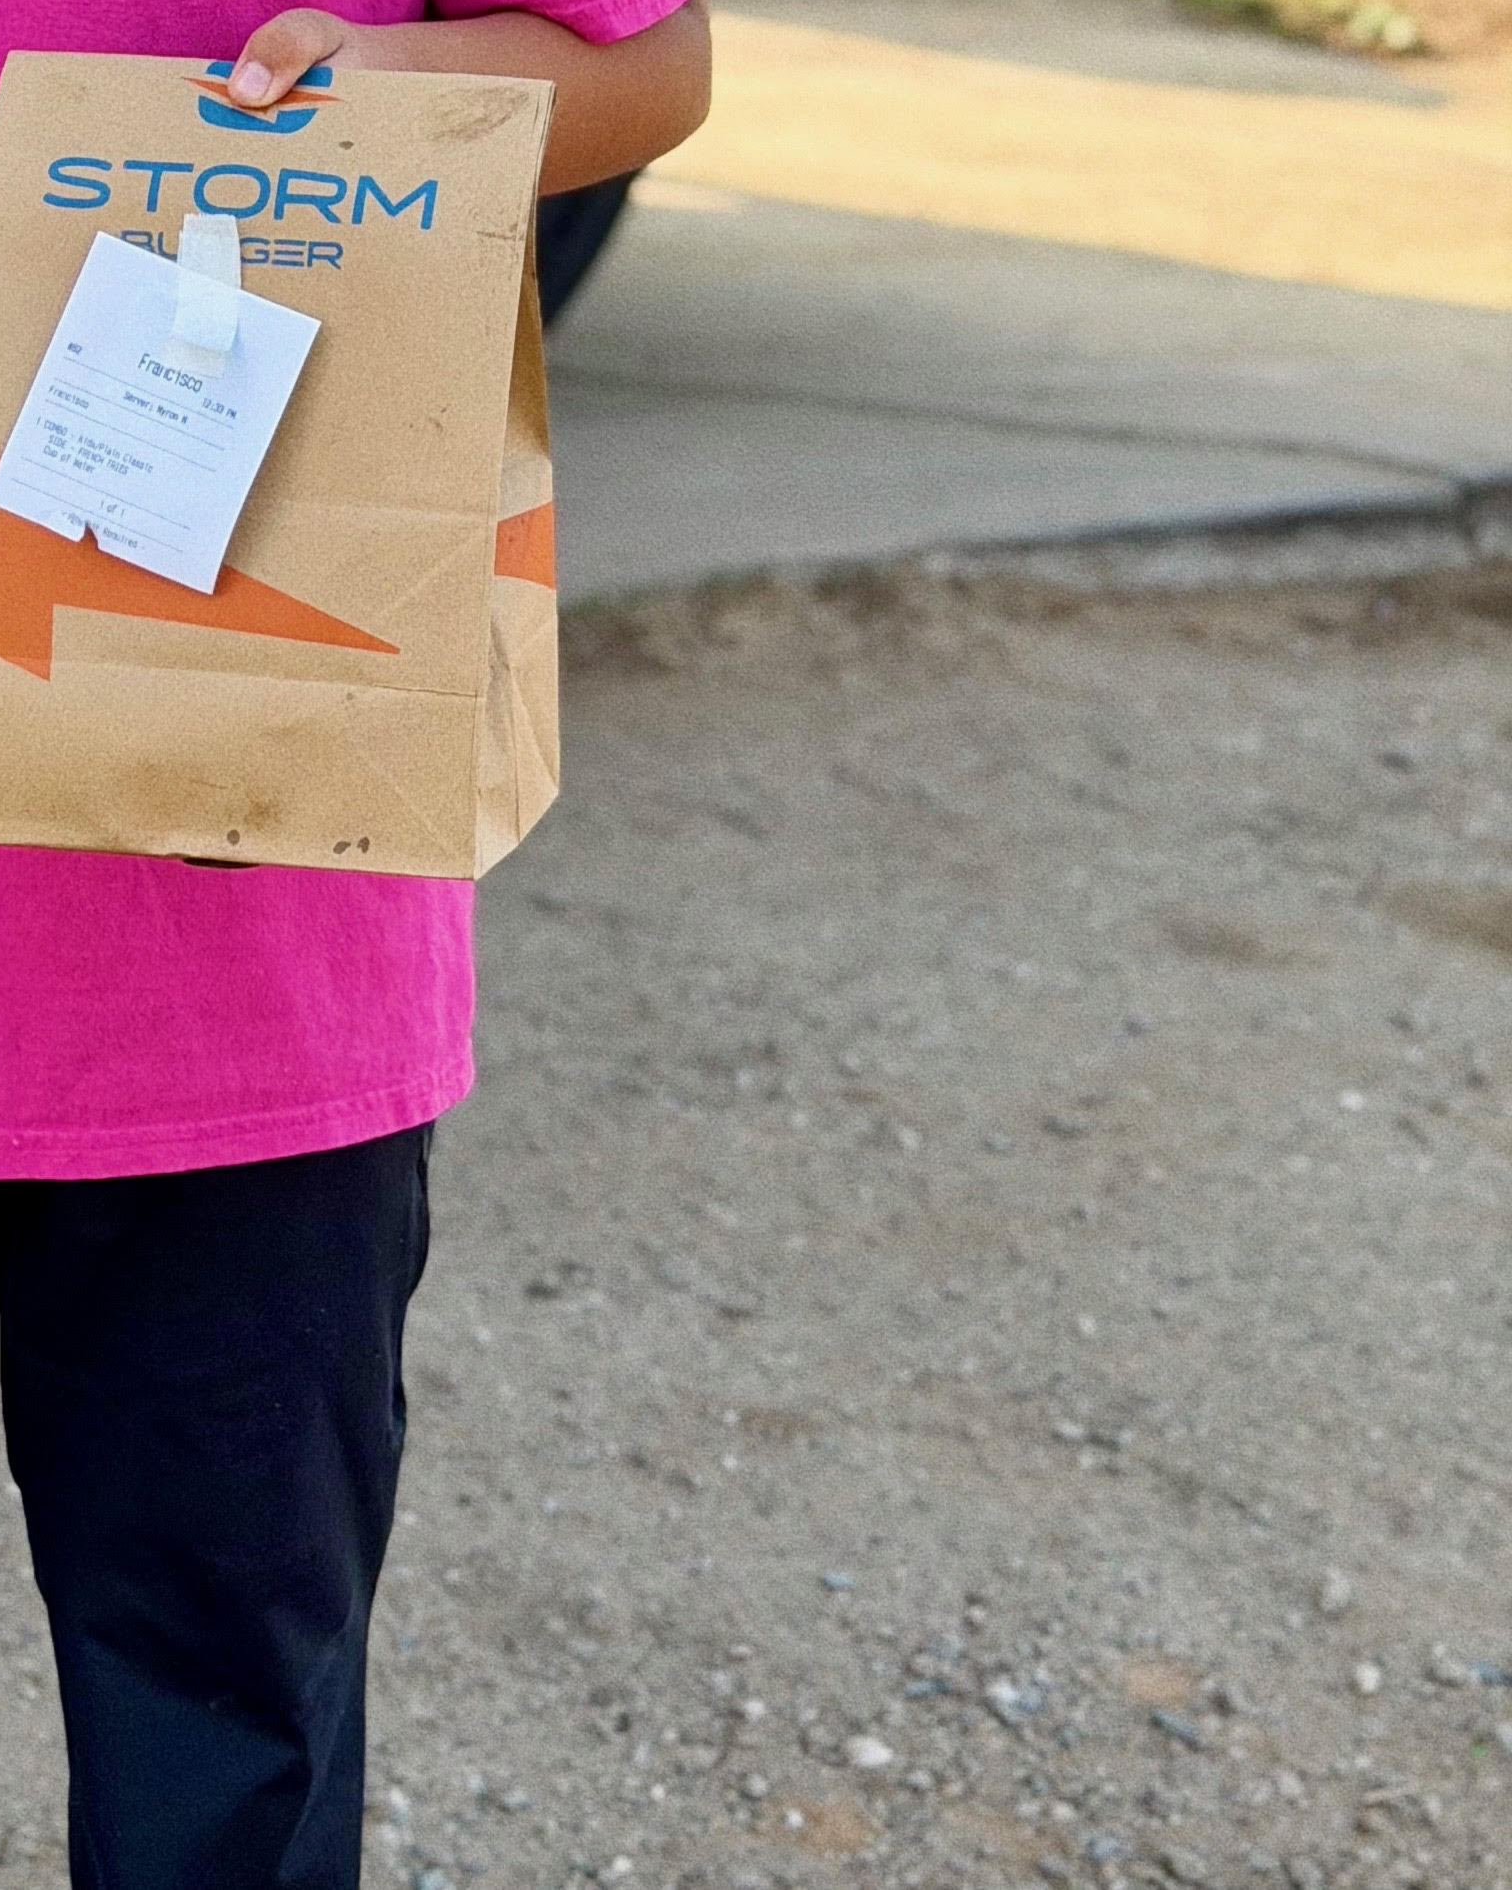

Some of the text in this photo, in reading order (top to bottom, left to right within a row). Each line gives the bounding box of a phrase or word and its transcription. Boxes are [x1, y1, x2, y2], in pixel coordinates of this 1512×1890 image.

[42, 157, 439, 230] STORM
[120, 229, 344, 270] BUGER
[138, 353, 203, 393] Francisco
